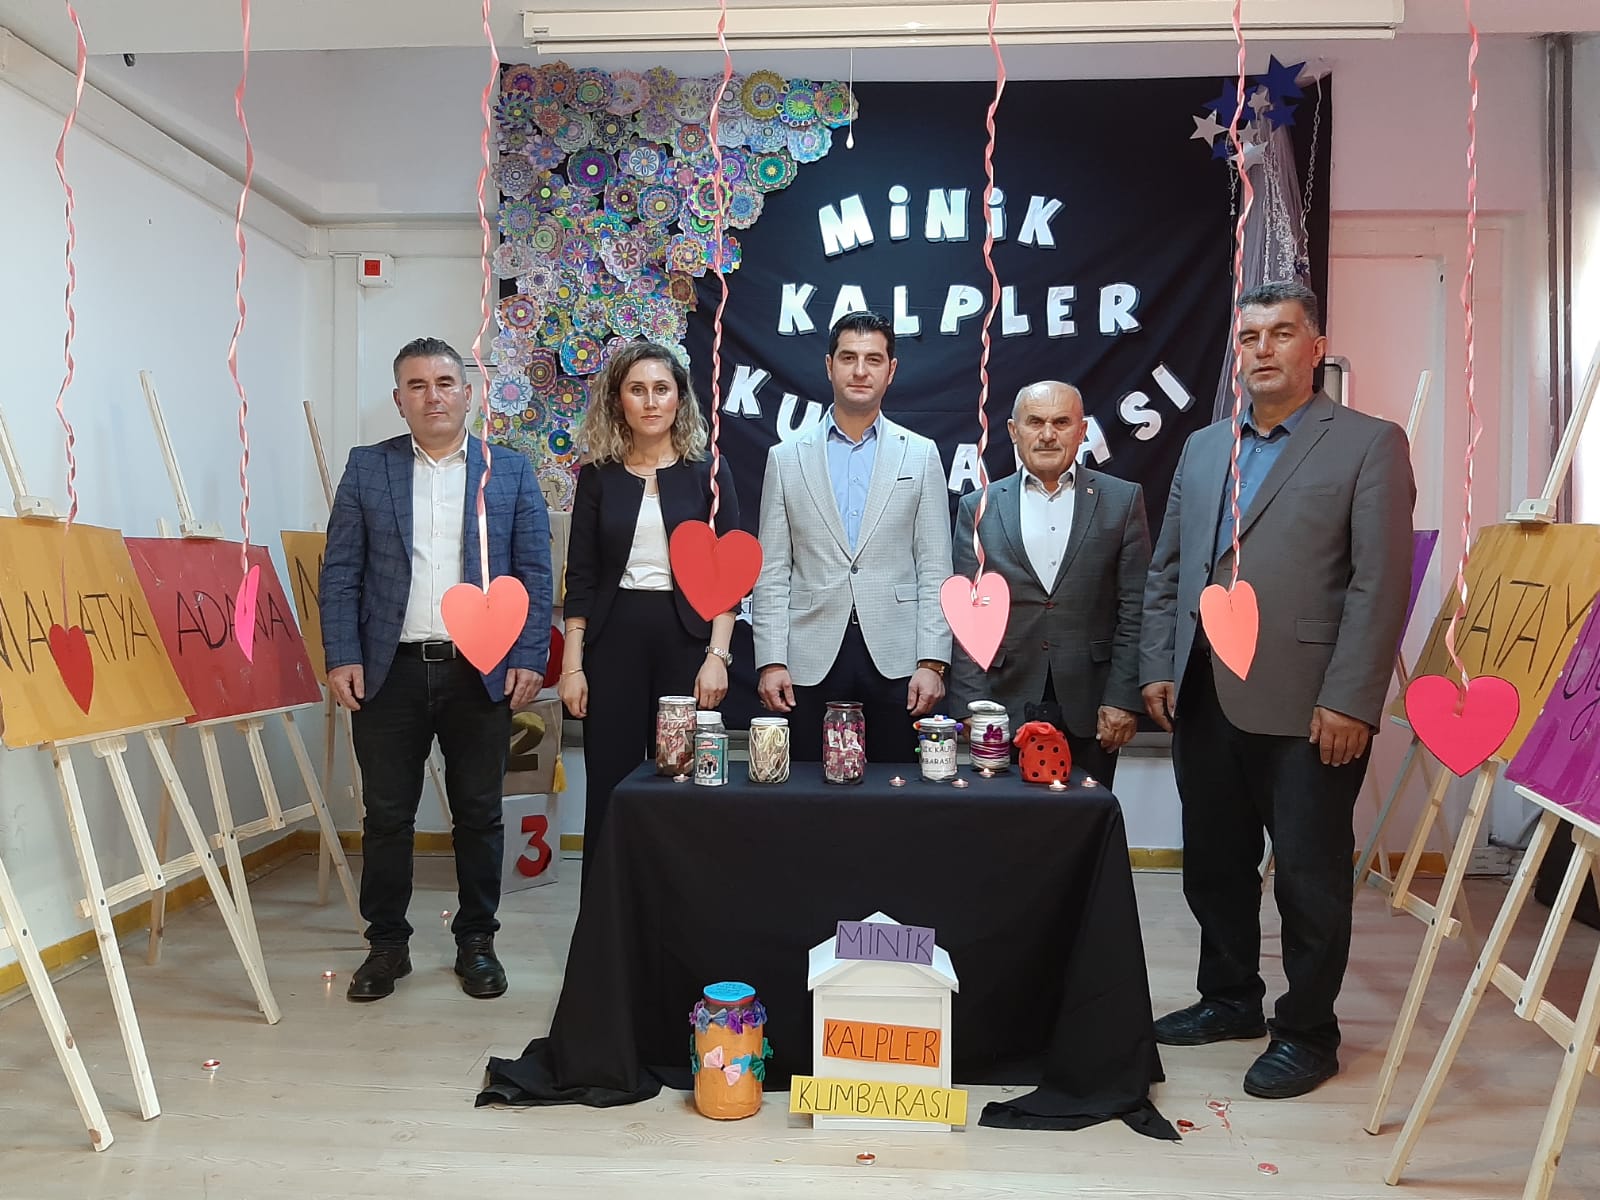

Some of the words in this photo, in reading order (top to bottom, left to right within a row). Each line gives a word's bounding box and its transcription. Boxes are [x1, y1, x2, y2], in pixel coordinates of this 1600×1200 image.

[777, 281, 1142, 339] KALPLER
[722, 361, 1196, 496] KUAASI
[1423, 567, 1598, 698] HATAY
[516, 814, 553, 878] 3
[837, 923, 933, 962] MİNİK
[825, 1023, 937, 1064] KALPLER
[799, 1080, 951, 1119] KUMBARASI
